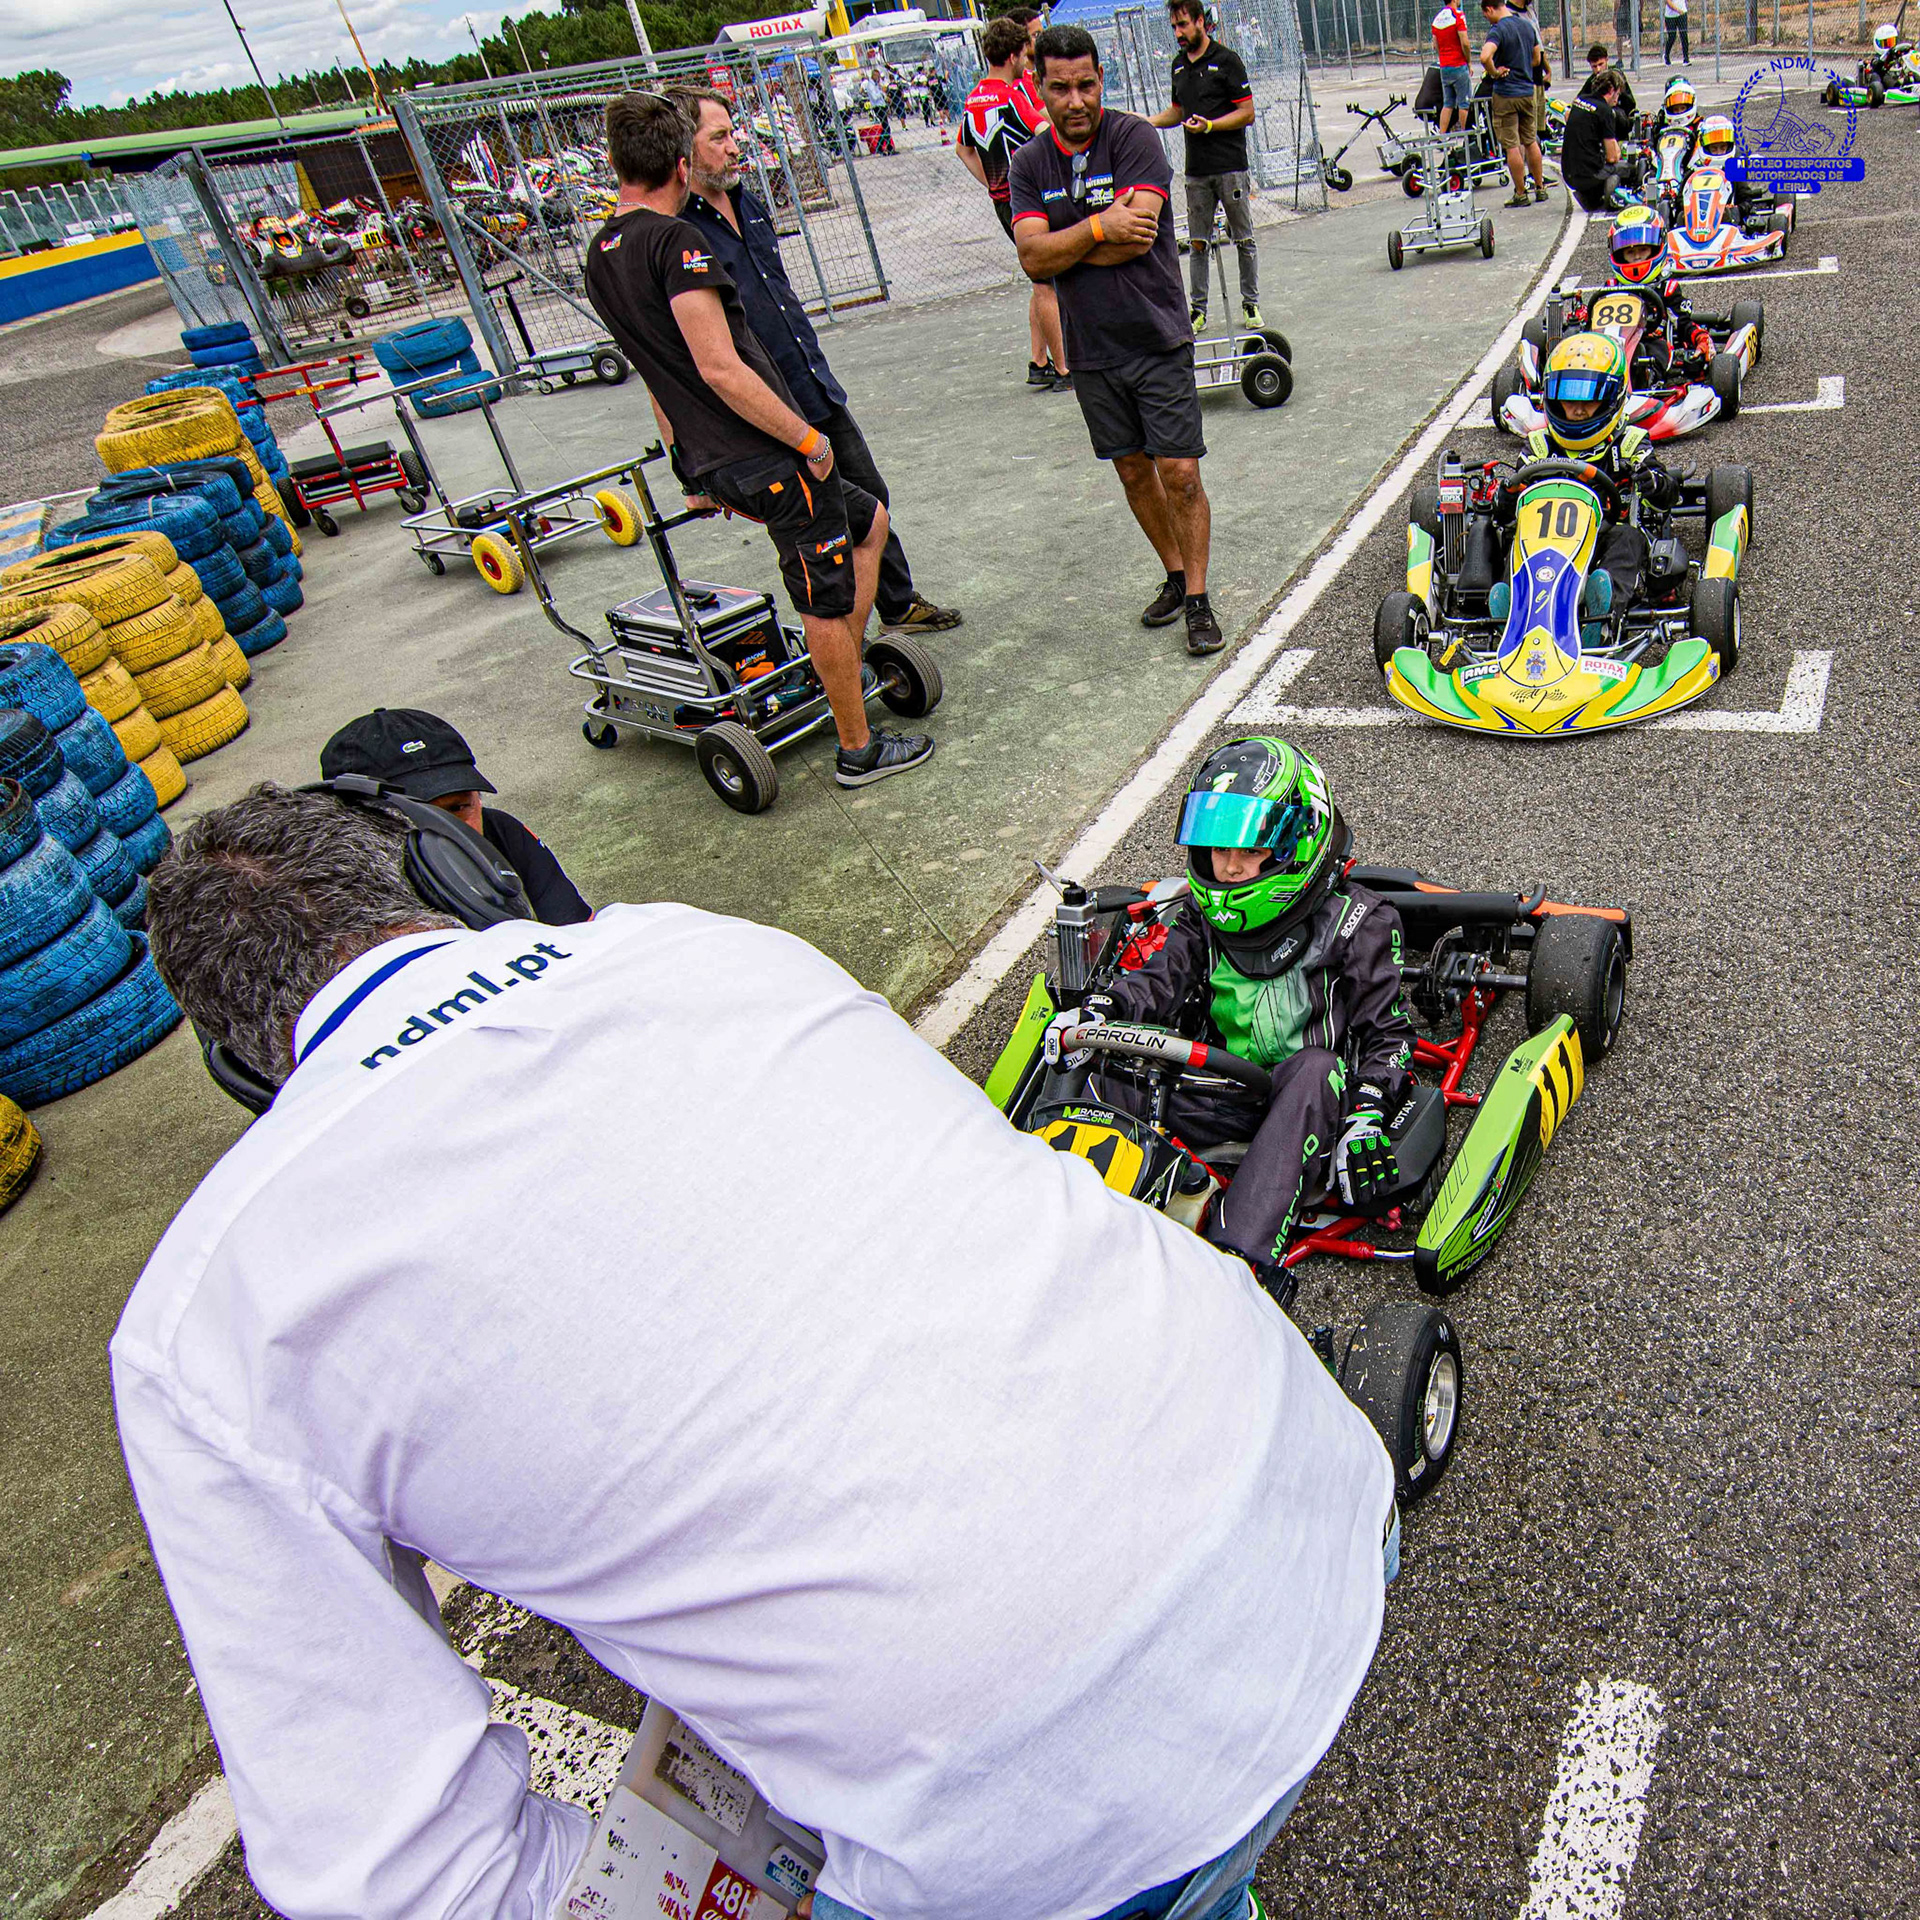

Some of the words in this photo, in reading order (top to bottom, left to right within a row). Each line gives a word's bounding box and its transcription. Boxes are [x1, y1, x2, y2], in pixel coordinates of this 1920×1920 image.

[749, 18, 804, 38] ROTAX
[1702, 176, 1713, 187] 7
[683, 263, 708, 271] RACING
[1596, 303, 1634, 327] 88
[1537, 501, 1579, 539] 10
[1465, 664, 1500, 680] RMC
[1584, 660, 1625, 675] ROTAX
[1584, 667, 1625, 679] RACING
[1340, 903, 1367, 939] sparco
[360, 943, 572, 1069] ndml.pt
[1085, 1028, 1167, 1050] PAROLIN
[1540, 1040, 1574, 1132] 11
[1080, 1107, 1115, 1120] RACING
[1091, 1116, 1113, 1126] ONE
[1390, 1100, 1417, 1129] ROTAX
[778, 1854, 810, 1882] 2016
